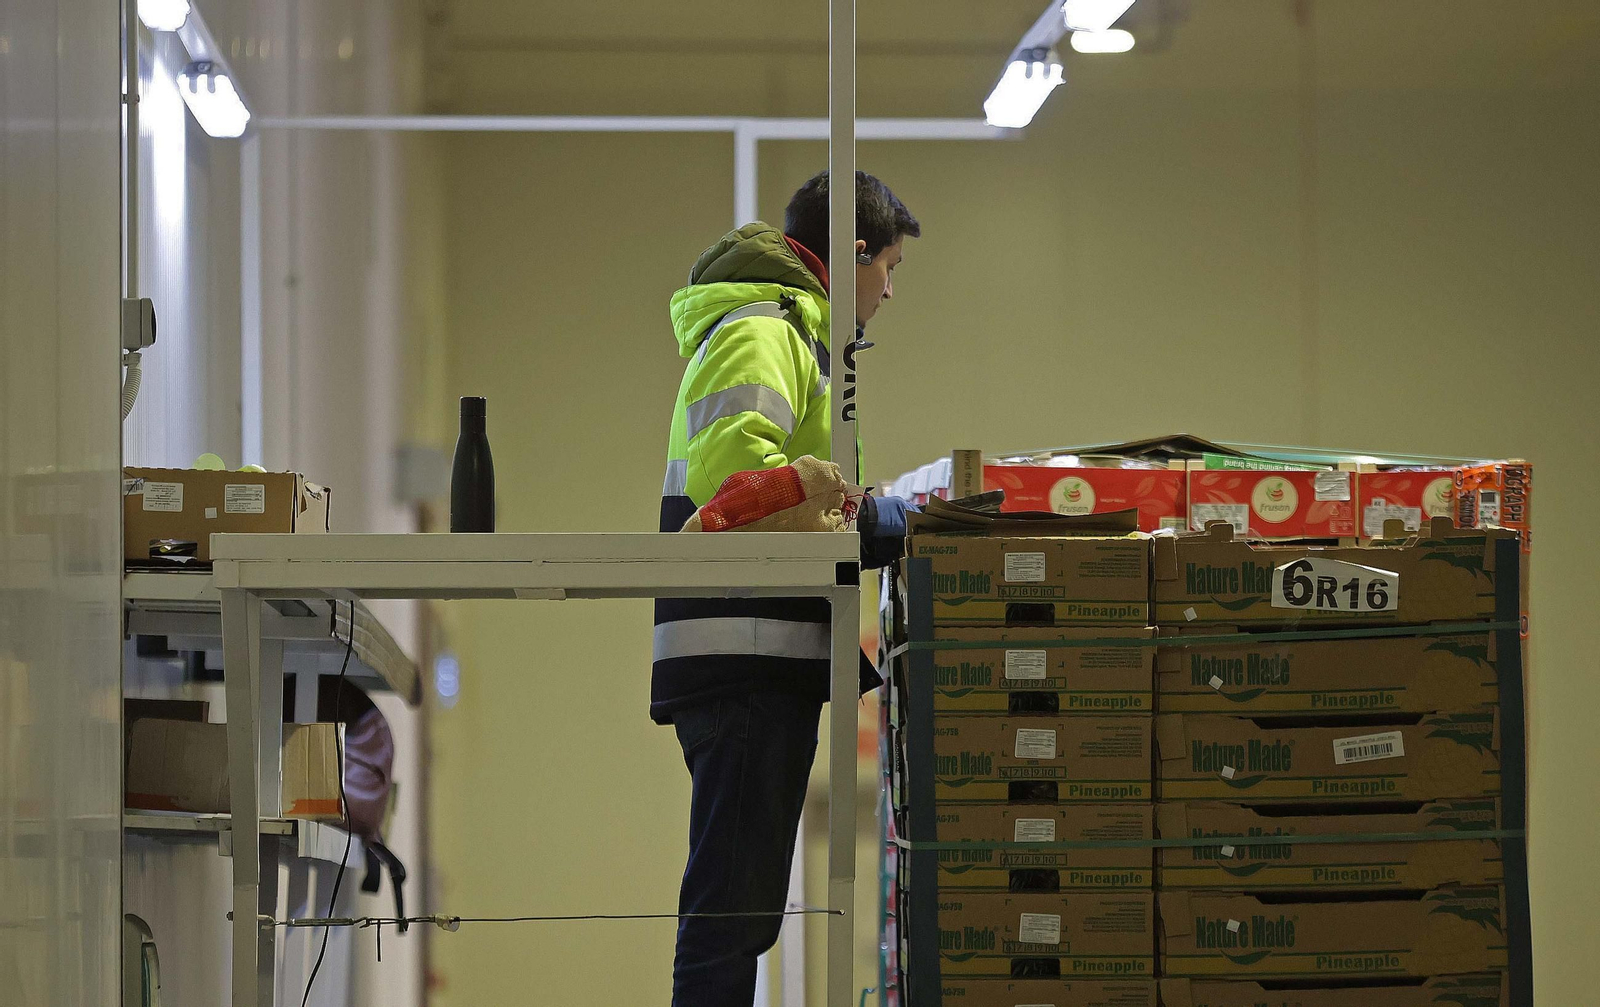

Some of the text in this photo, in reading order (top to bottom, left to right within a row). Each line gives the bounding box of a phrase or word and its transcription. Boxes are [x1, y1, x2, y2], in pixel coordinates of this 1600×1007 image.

[959, 570, 991, 594] Made
[1186, 561, 1275, 595] Nature Mad
[1283, 559, 1389, 610] 6R16
[1067, 604, 1140, 619] Pineapple
[960, 662, 992, 686] Made
[1191, 652, 1290, 686] Nature Made
[1069, 695, 1142, 709] Pineapple
[1311, 692, 1394, 708] Pineapple
[960, 751, 992, 776] Made
[1192, 739, 1292, 773] Nature Made
[1069, 785, 1142, 799] Pineapple
[1312, 778, 1396, 795] Pineapple
[1070, 872, 1143, 885] Pineapple
[1312, 866, 1396, 883] Pineapple
[963, 926, 996, 950] Made
[1251, 915, 1296, 948] Made
[1072, 959, 1146, 973] Pineapple
[1316, 954, 1400, 971] Pineapple
